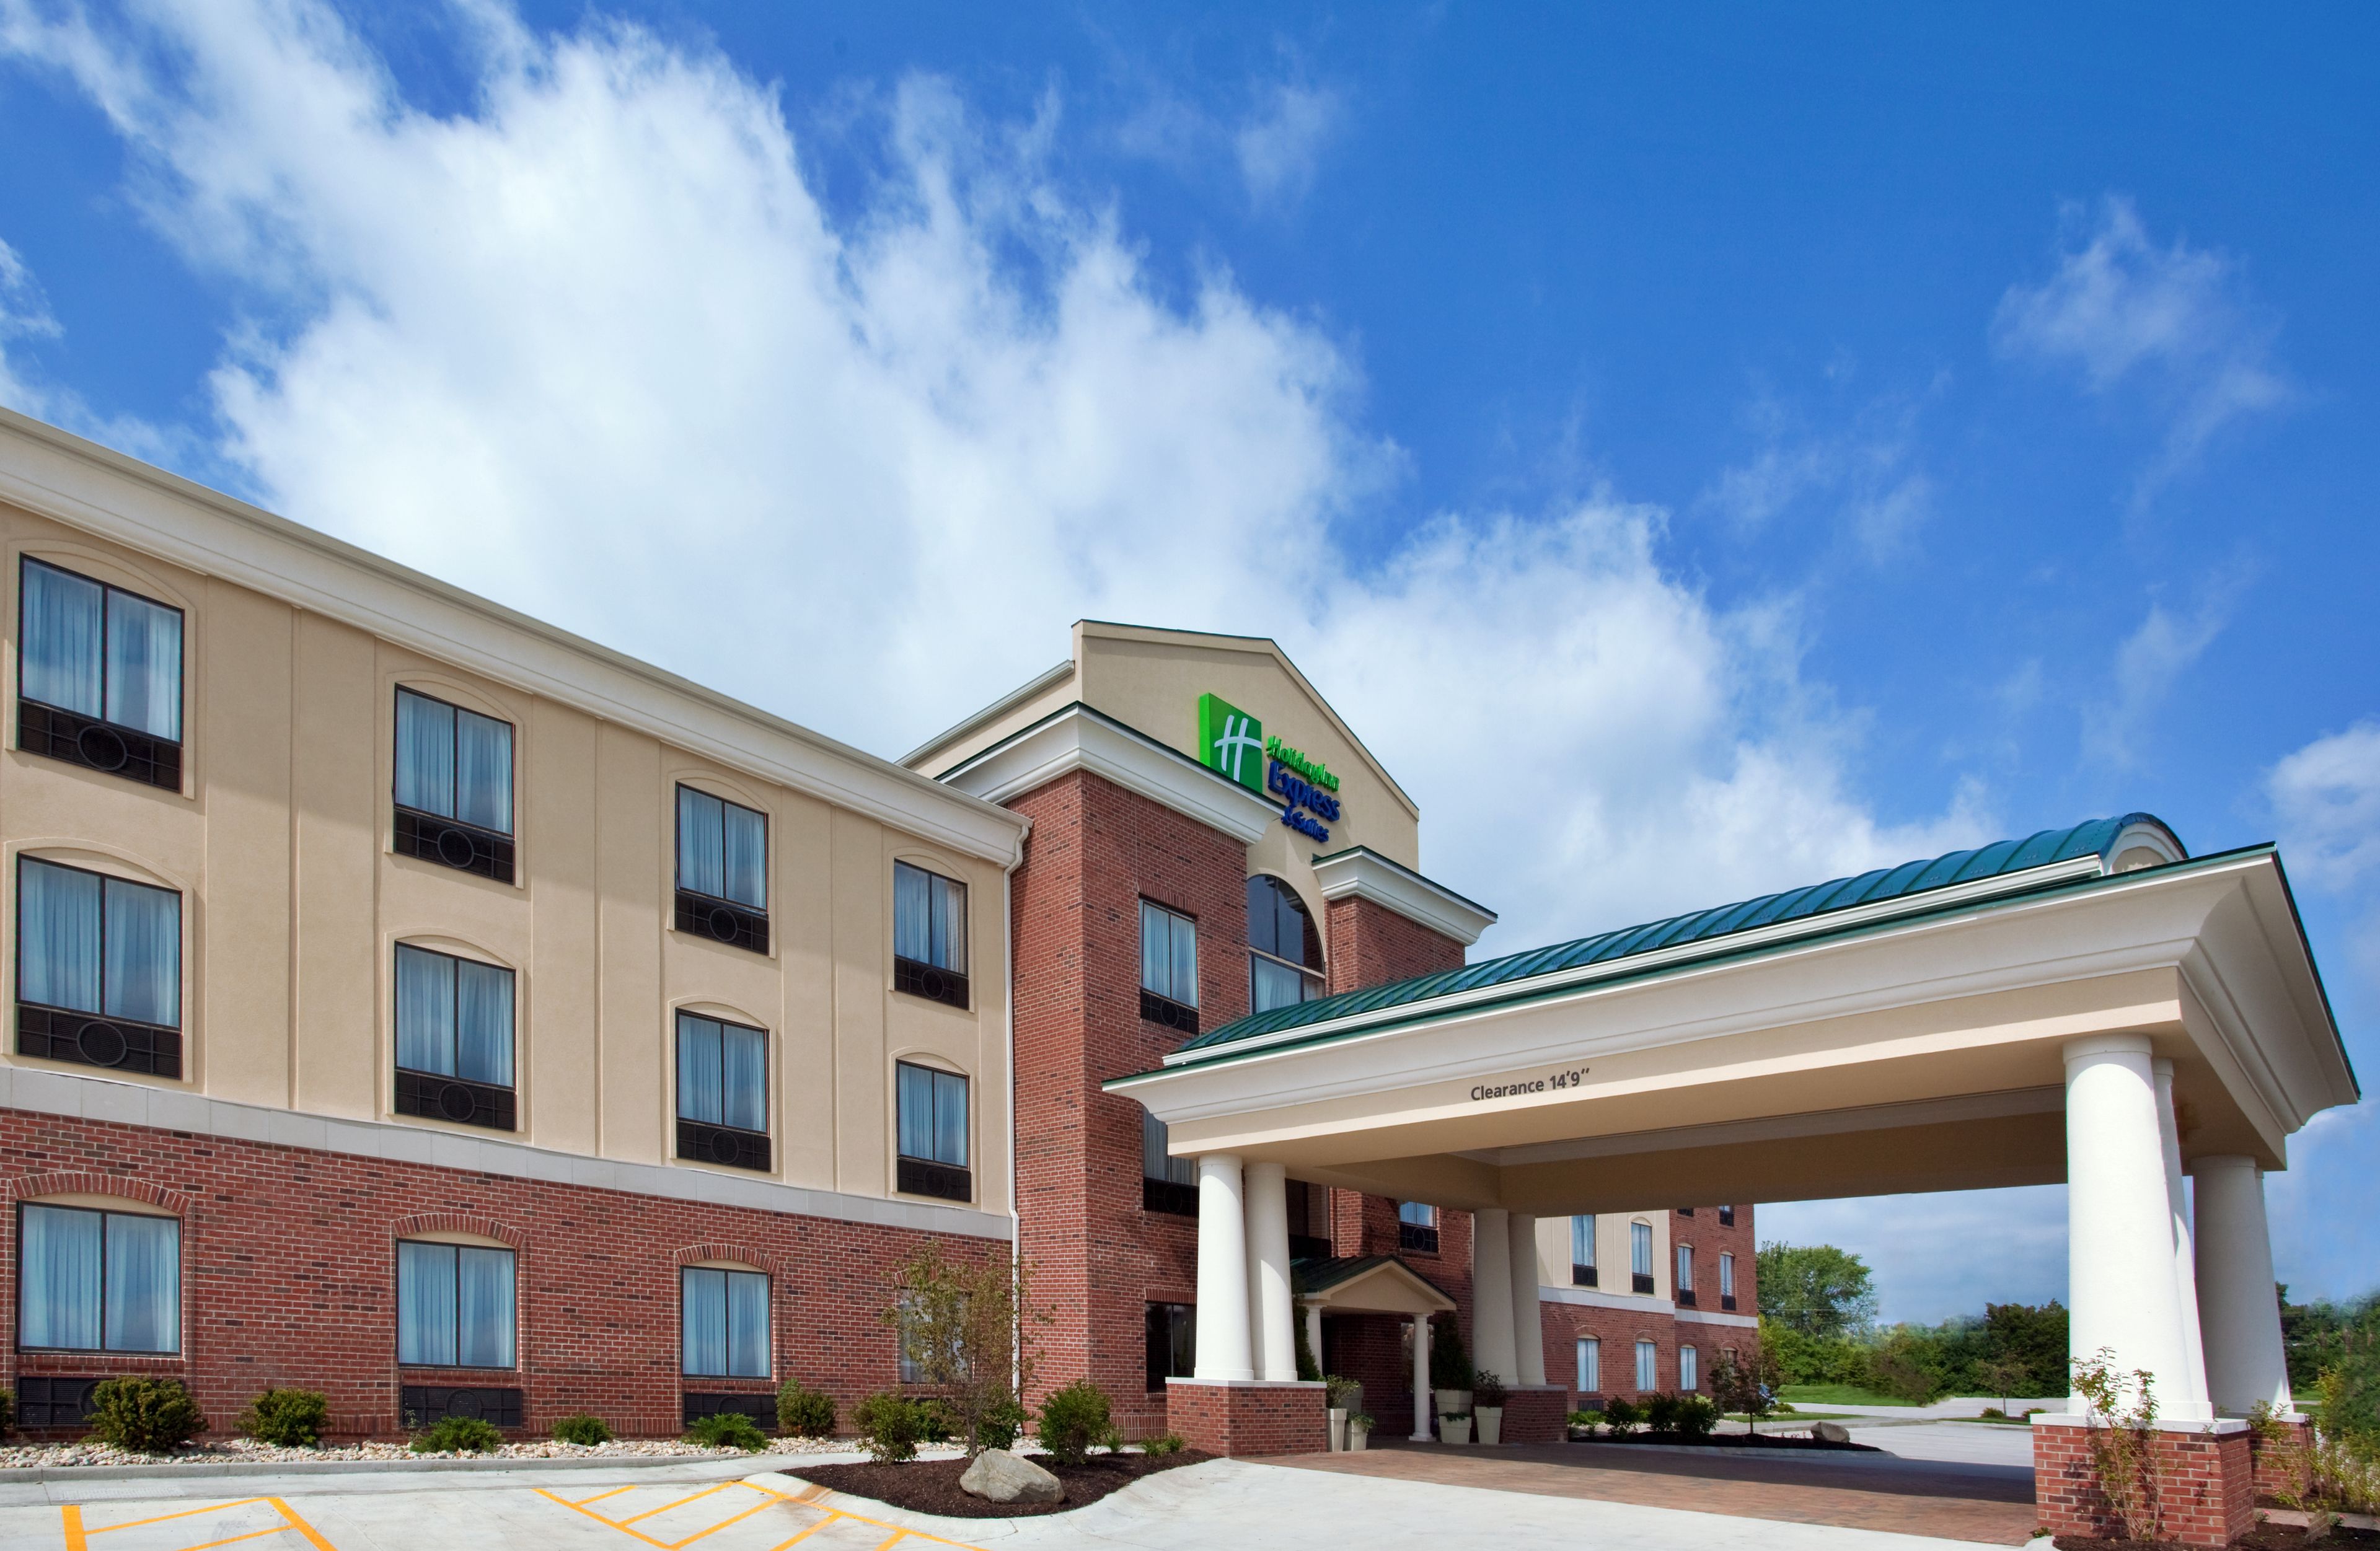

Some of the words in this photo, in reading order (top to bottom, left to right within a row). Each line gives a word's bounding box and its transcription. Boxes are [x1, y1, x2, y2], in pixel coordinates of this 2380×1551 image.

[1266, 736, 1320, 784] Holiday
[1318, 763, 1339, 793] Inn
[1268, 760, 1341, 822] Express
[1281, 806, 1294, 826] &
[1291, 811, 1329, 843] Suites
[1471, 1080, 1545, 1101] Clearance
